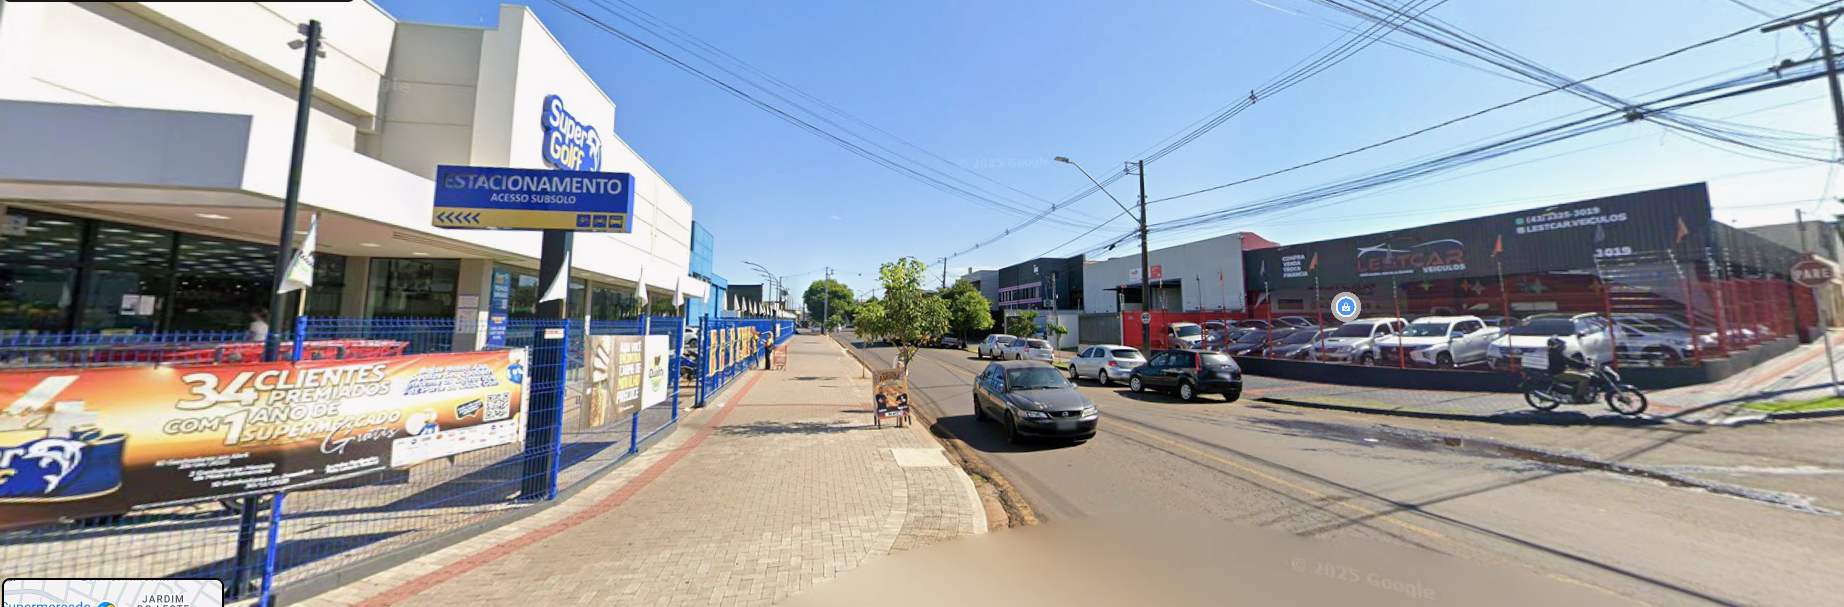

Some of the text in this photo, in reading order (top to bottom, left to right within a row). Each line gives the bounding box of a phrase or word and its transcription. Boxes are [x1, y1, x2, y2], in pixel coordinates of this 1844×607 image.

[550, 98, 587, 147] Super
[551, 131, 585, 171] Golff
[444, 172, 622, 195] ESTACIONAMENTO
[490, 193, 576, 204] ACESSO SUBSOLO
[1282, 254, 1306, 262] COMPRA
[1357, 249, 1465, 273] LESTCAR
[1422, 263, 1467, 273] VEICULOS
[1795, 268, 1831, 279] PARE
[254, 364, 386, 390] CLIENTES
[176, 371, 258, 411] 34
[268, 379, 391, 406] PREMIADOS
[239, 409, 402, 442] SUPERMERCADO
[250, 402, 340, 424] ANO DE
[163, 409, 250, 446] COM 1
